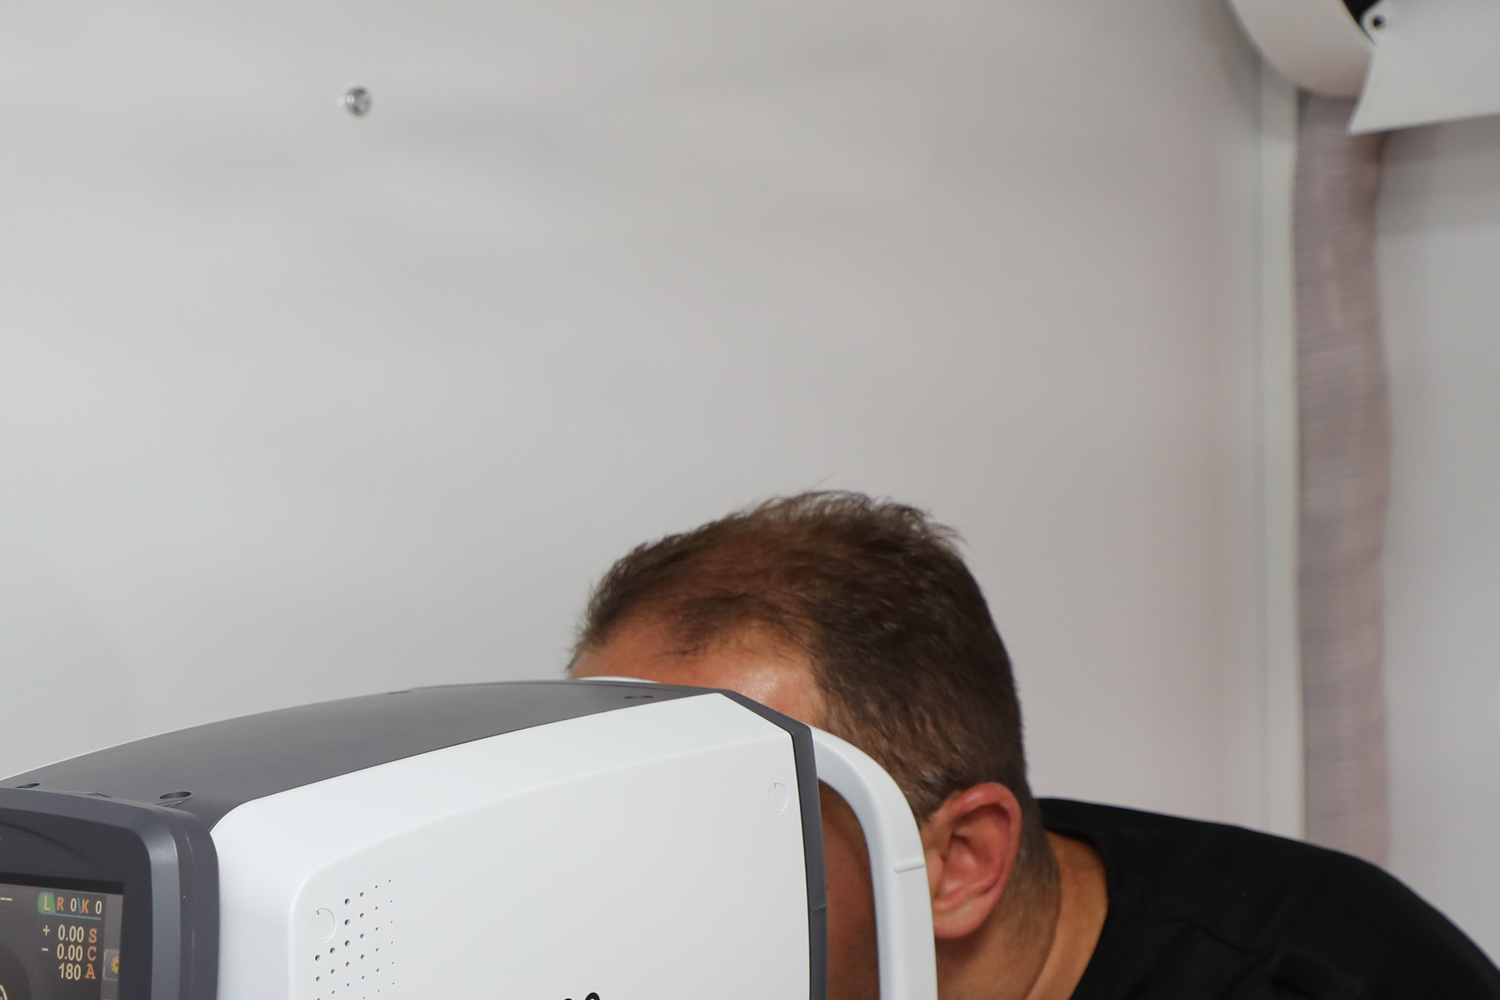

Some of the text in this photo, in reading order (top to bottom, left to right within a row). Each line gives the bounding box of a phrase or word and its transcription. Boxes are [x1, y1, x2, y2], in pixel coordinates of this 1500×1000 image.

[43, 895, 51, 911] L
[57, 924, 85, 943] 0.00
[56, 943, 83, 961] 0.00
[58, 963, 81, 981] 180
